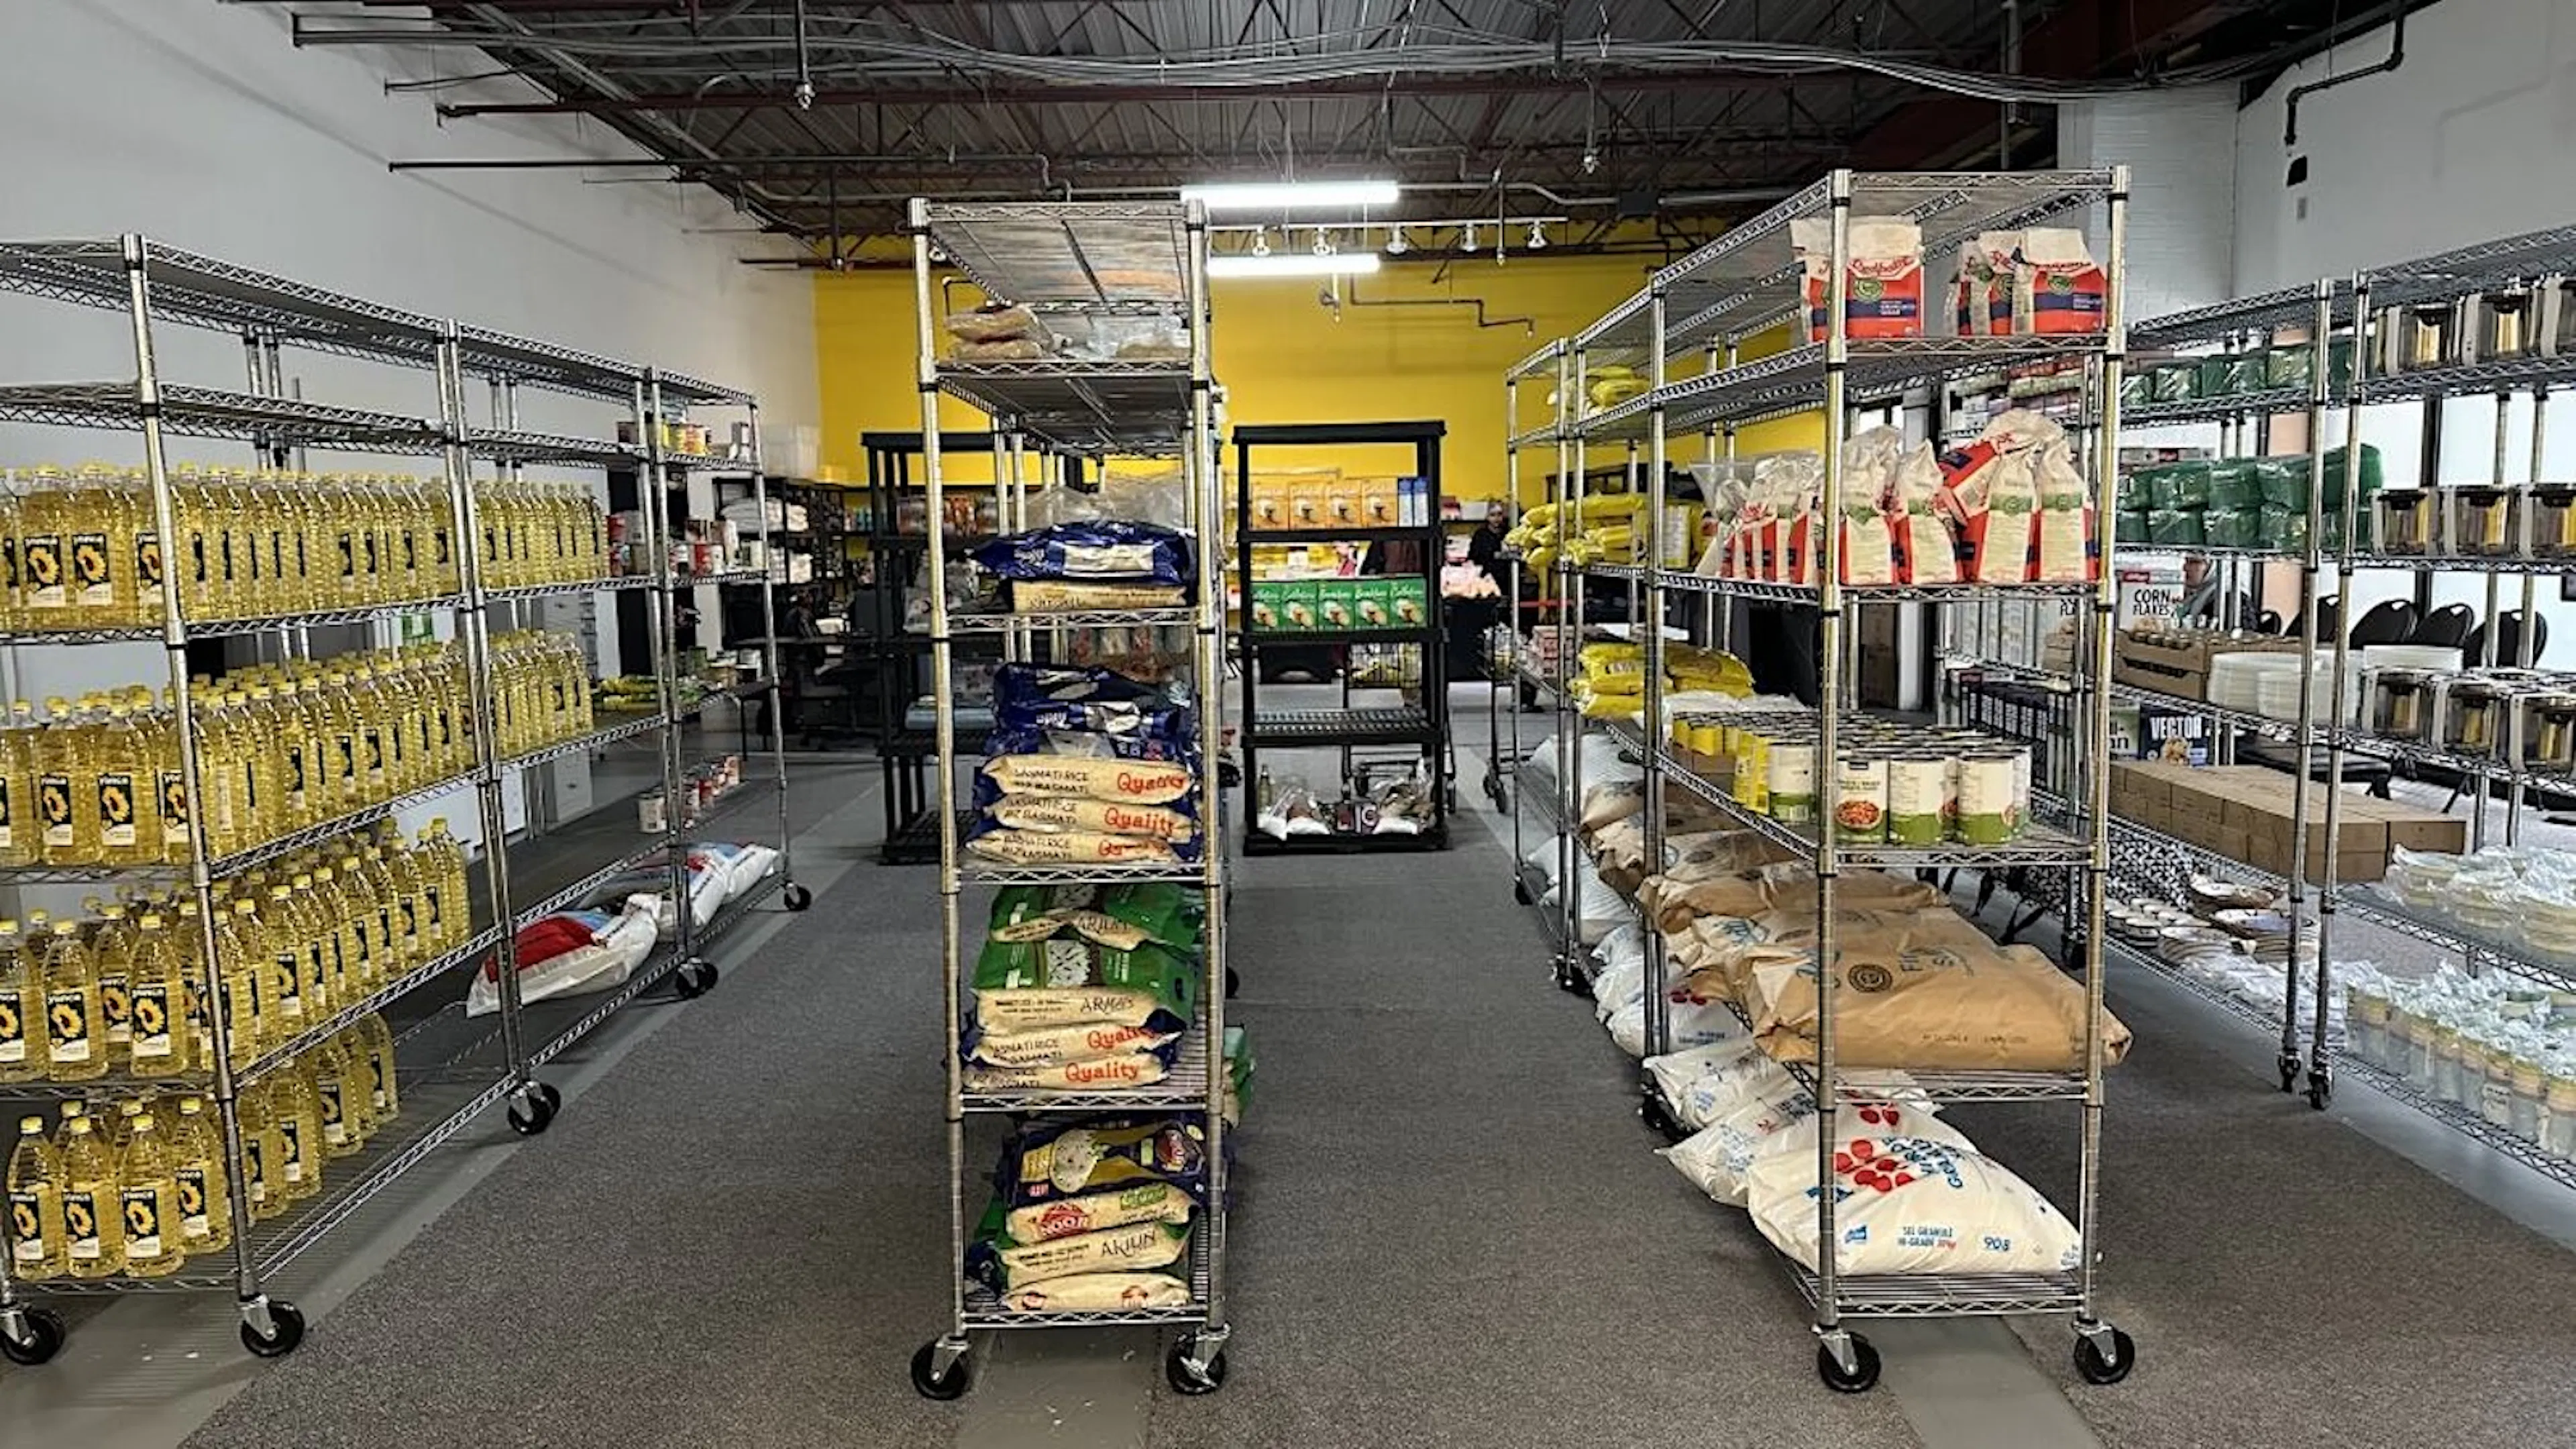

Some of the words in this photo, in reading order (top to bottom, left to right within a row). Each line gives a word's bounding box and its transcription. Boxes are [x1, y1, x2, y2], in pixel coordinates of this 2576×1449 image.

[2134, 588, 2171, 603] CORN
[2133, 605, 2171, 616] FLAKES
[2149, 715, 2202, 741] VECTOR
[1104, 807, 1175, 836] Quality
[1065, 1061, 1140, 1083] Quality
